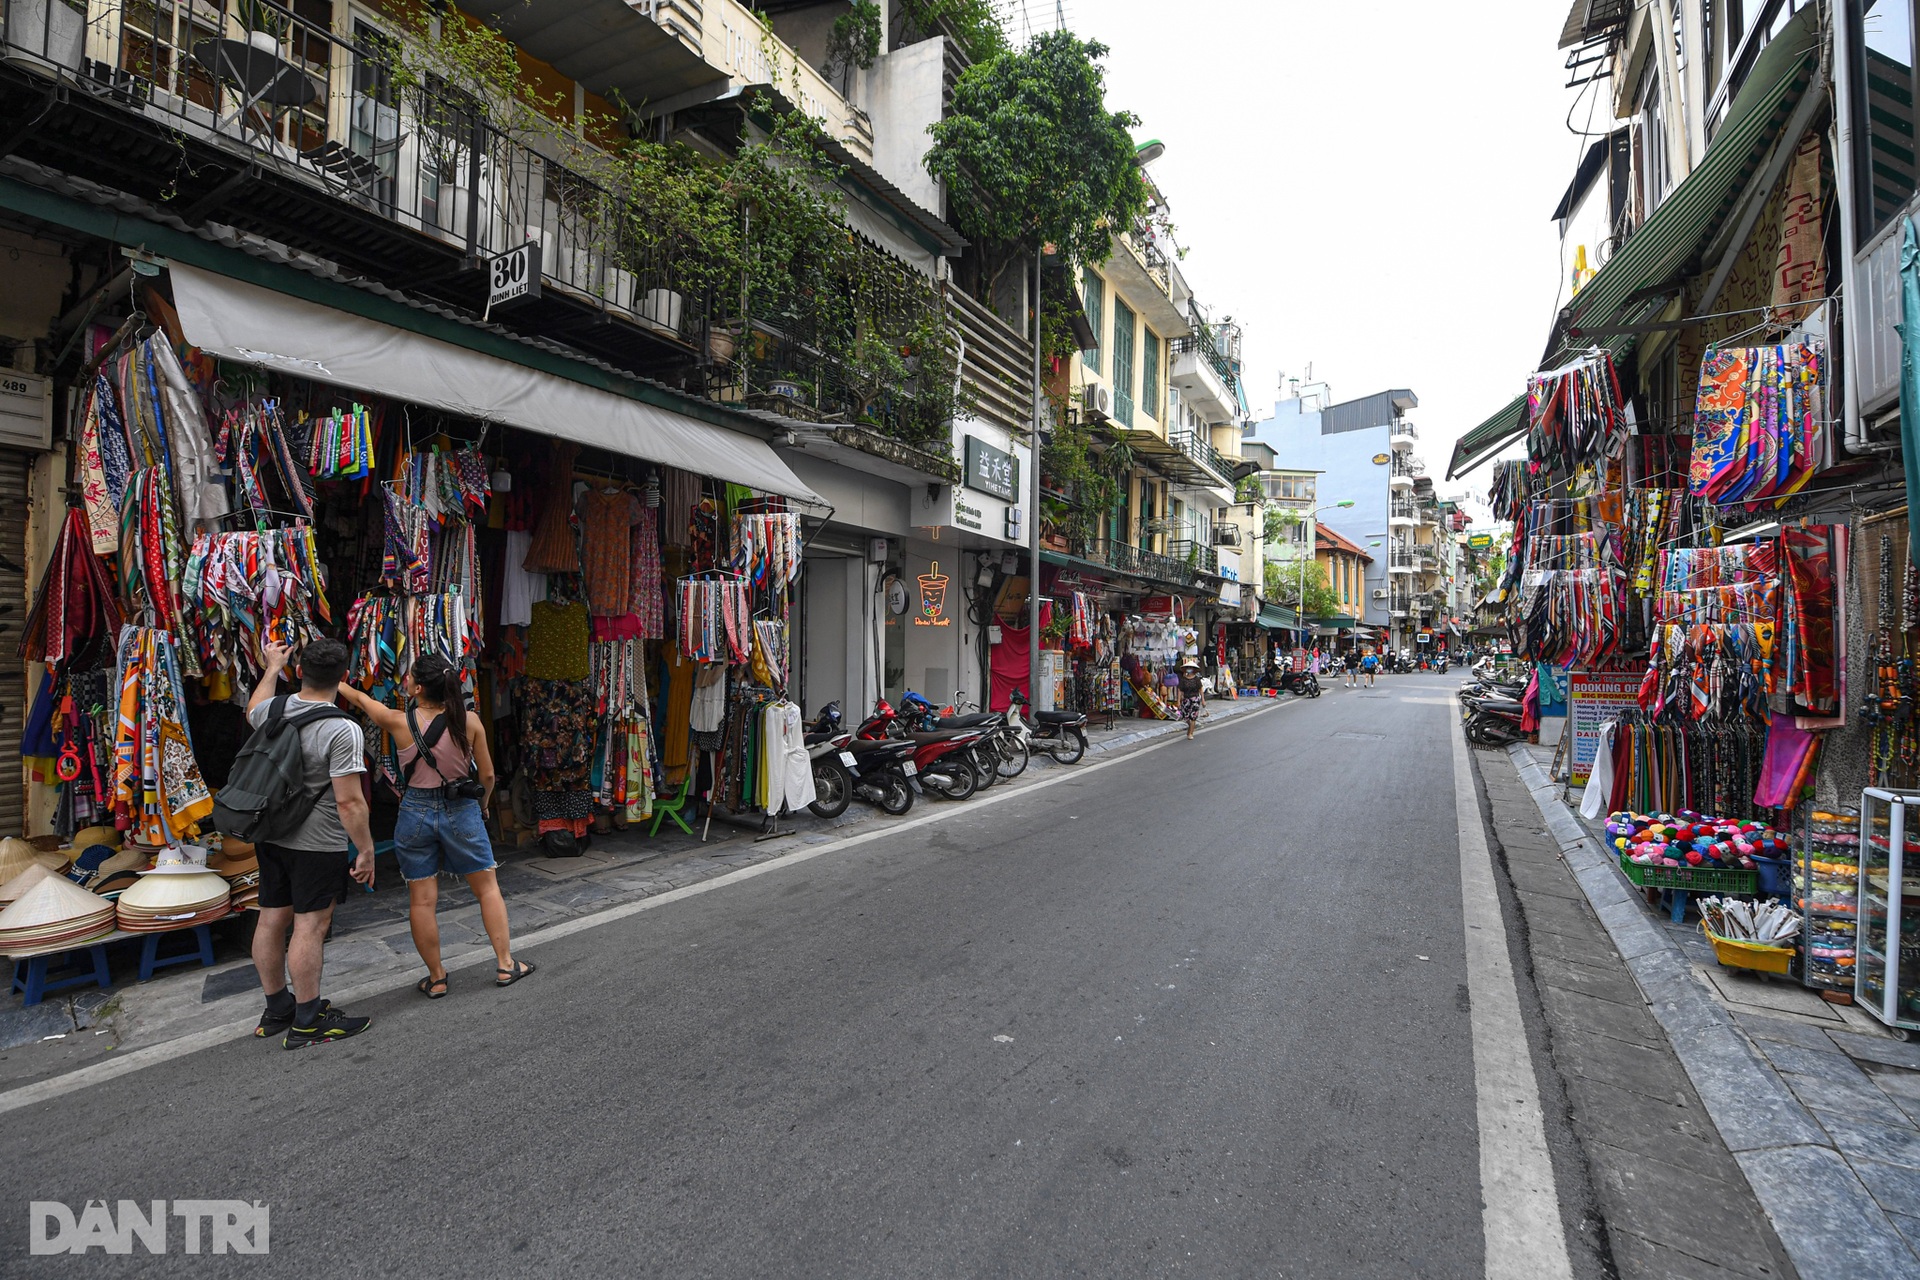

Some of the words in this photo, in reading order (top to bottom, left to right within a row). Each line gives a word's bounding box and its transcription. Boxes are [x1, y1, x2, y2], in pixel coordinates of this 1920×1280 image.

[494, 250, 526, 289] 30
[491, 289, 510, 304] ĐINH
[512, 282, 528, 297] LIỆT
[2, 380, 27, 393] 489
[978, 450, 1012, 488] 益禾堂
[984, 480, 1012, 497] YIHETANG
[1573, 683, 1621, 693] BOOKING
